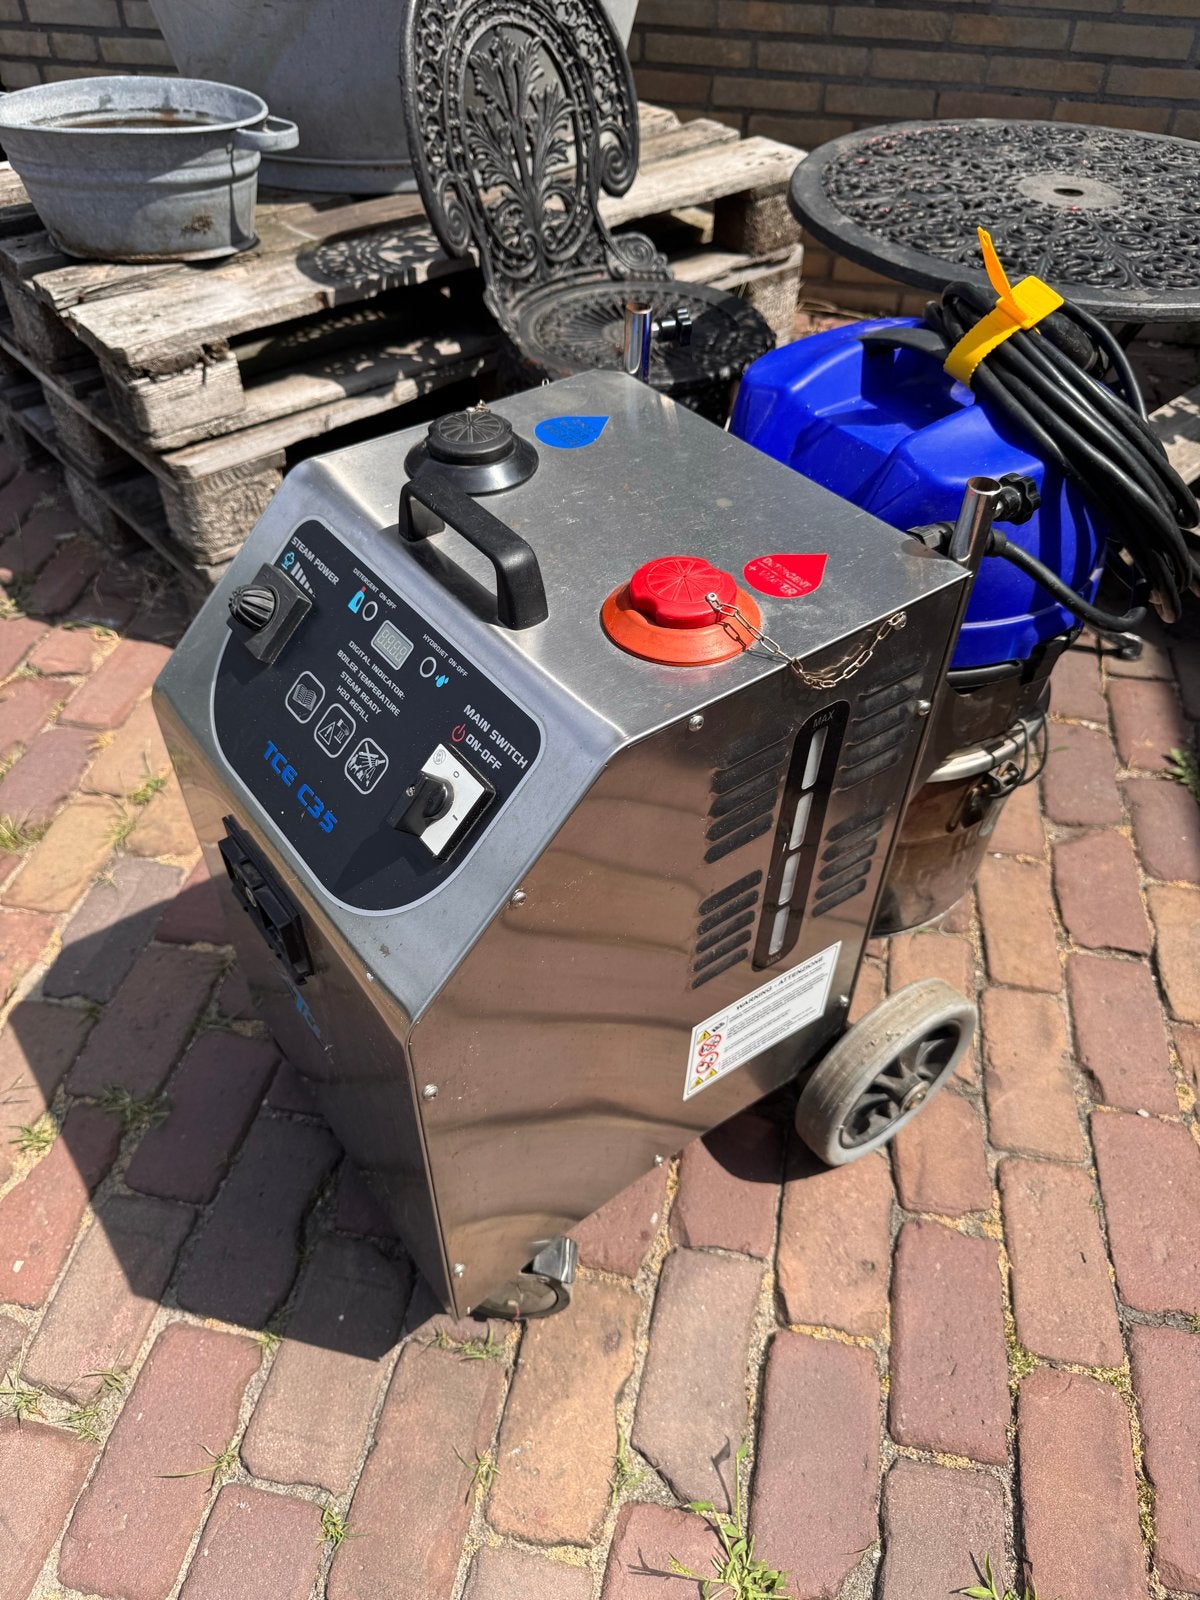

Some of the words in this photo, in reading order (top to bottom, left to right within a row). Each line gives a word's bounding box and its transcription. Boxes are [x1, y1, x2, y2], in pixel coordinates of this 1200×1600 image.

[291, 536, 316, 562] STEAM
[313, 558, 340, 586] POWER
[352, 567, 379, 593] DETERGENT
[378, 592, 398, 610] ON-OFF
[348, 640, 371, 666] DIGITAL
[371, 663, 406, 700] INDICATOR:
[422, 633, 449, 660] HYDROJET
[448, 657, 469, 678] ON-OFF
[336, 649, 359, 673] BOILER
[357, 668, 401, 717] TEMPERATURE
[340, 671, 362, 695] STEAM
[360, 691, 382, 715] READY
[348, 698, 369, 723] REFILL
[812, 708, 836, 729] MAX
[463, 704, 491, 733] MAIN
[489, 729, 529, 769] SWITCH
[465, 733, 503, 771] ON-OFF
[264, 740, 298, 787] TCE
[297, 783, 338, 833] C35
[736, 985, 773, 1010] WARNING
[778, 955, 823, 985] ATTENZIONE
